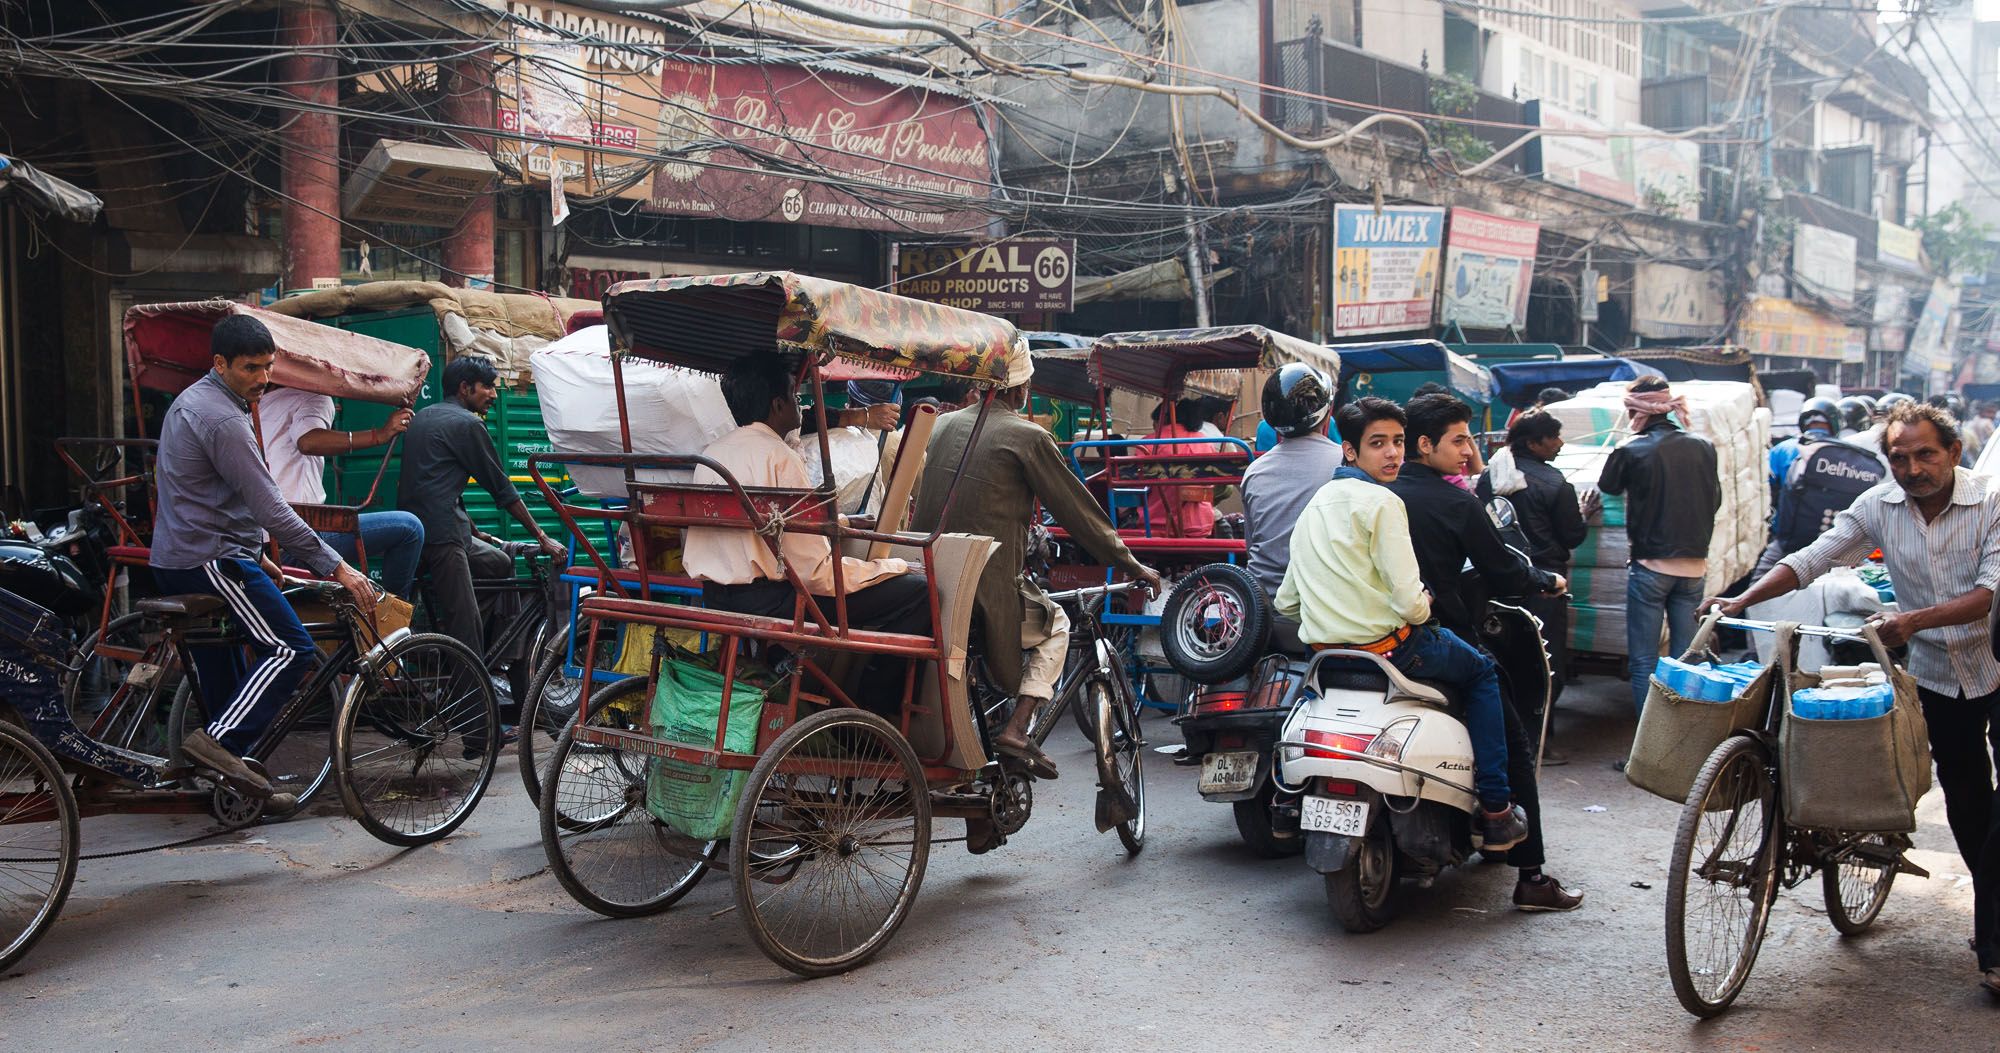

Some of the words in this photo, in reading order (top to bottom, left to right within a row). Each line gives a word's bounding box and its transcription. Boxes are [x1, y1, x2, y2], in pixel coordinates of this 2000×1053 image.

[732, 95, 823, 159] Royal
[827, 108, 891, 155] Card
[895, 120, 986, 167] Products
[947, 181, 975, 198] Cards
[681, 199, 691, 210] No
[692, 200, 715, 212] Branch
[784, 195, 802, 214] 66
[808, 202, 849, 216] CHAWRI
[886, 208, 945, 224] DELHI-110006
[1353, 213, 1432, 243] NUMEX
[901, 246, 1032, 275] ROYAL
[1038, 256, 1066, 279] 66
[900, 280, 941, 294] CARD
[945, 278, 1030, 293] PRODUCTS
[940, 297, 982, 309] SHOP
[1048, 292, 1062, 300] HAVE
[987, 301, 1006, 309] SINCE
[1435, 760, 1471, 772] Activa
